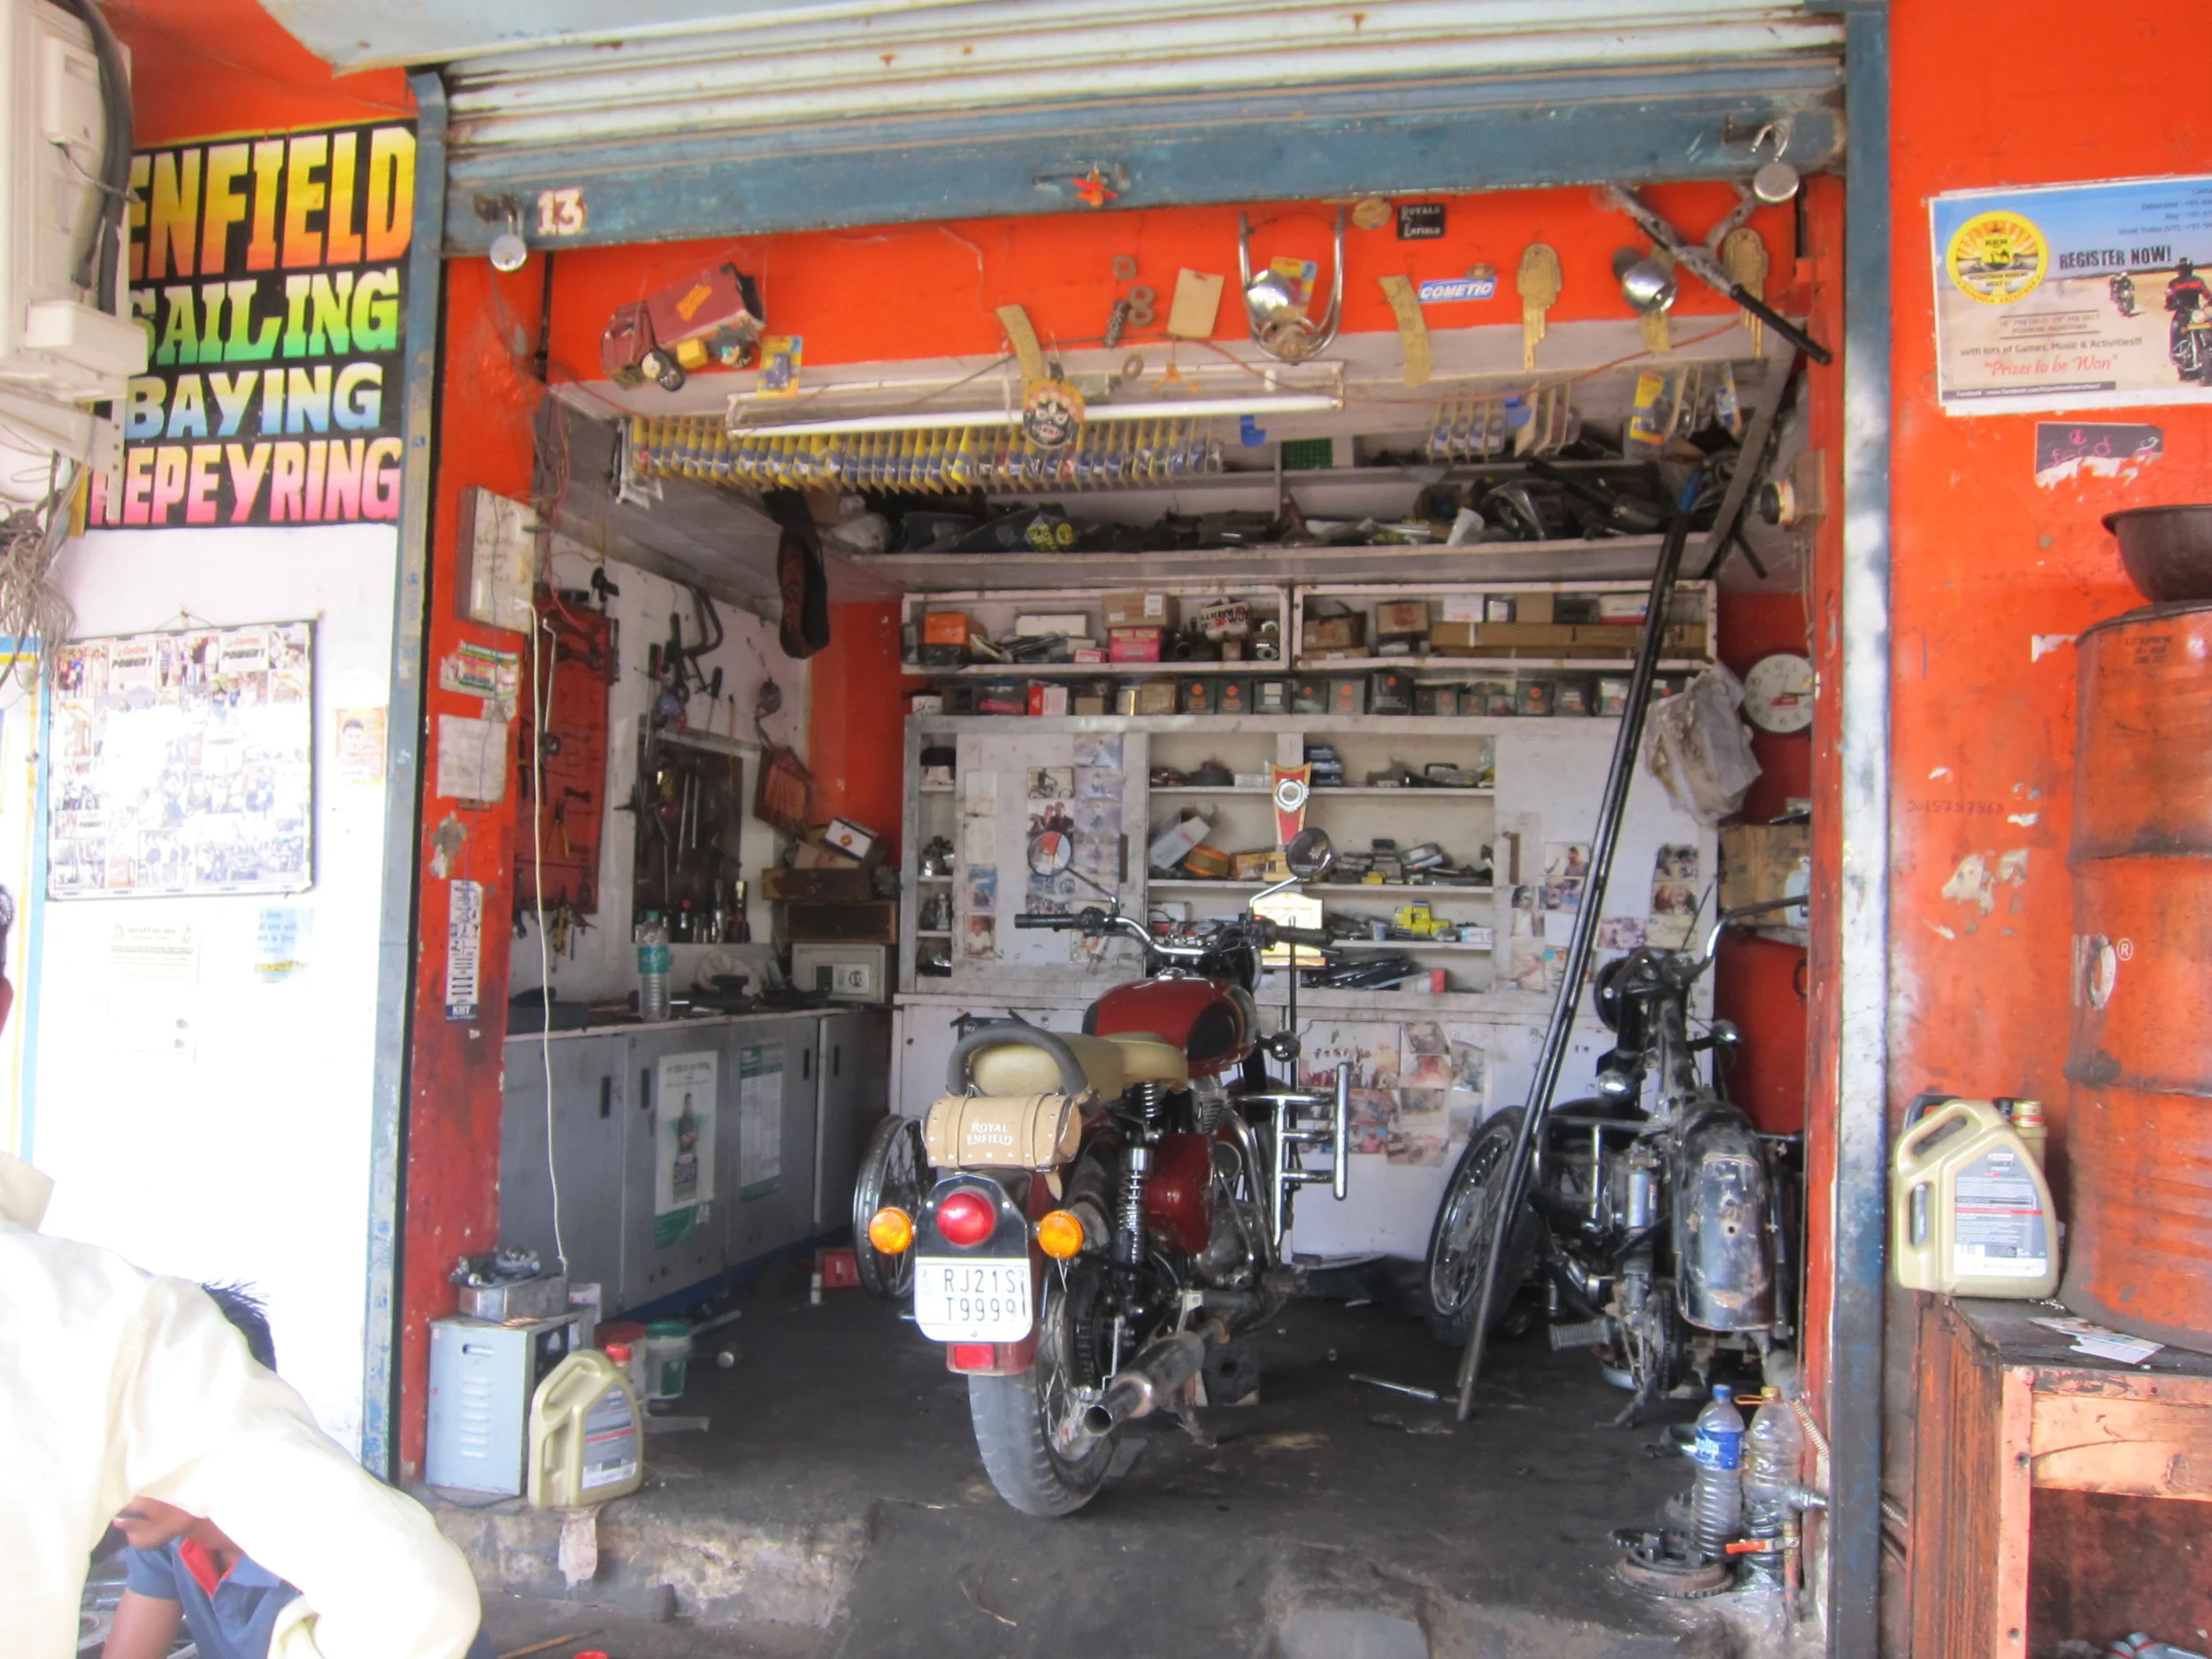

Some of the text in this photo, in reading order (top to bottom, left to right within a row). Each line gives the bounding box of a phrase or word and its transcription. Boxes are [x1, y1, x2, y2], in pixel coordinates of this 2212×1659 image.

[128, 127, 417, 280] ENFIELD
[537, 188, 585, 237] 13
[2059, 245, 2171, 269] REGISTER NOW!
[1419, 281, 1494, 299] COMETIC
[1961, 345, 1981, 356] with
[1983, 344, 2001, 355] lots
[2002, 343, 2012, 354] of
[2051, 341, 2077, 351] Music
[2079, 340, 2086, 349] &
[2036, 358, 2048, 373] to
[2052, 354, 2068, 372] be
[125, 362, 383, 441] BAYING
[971, 1118, 1009, 1133] ROYAL
[966, 1133, 1013, 1147] ENFIELD
[943, 1268, 1017, 1294] RJ21S
[944, 1296, 1017, 1323] T9999
